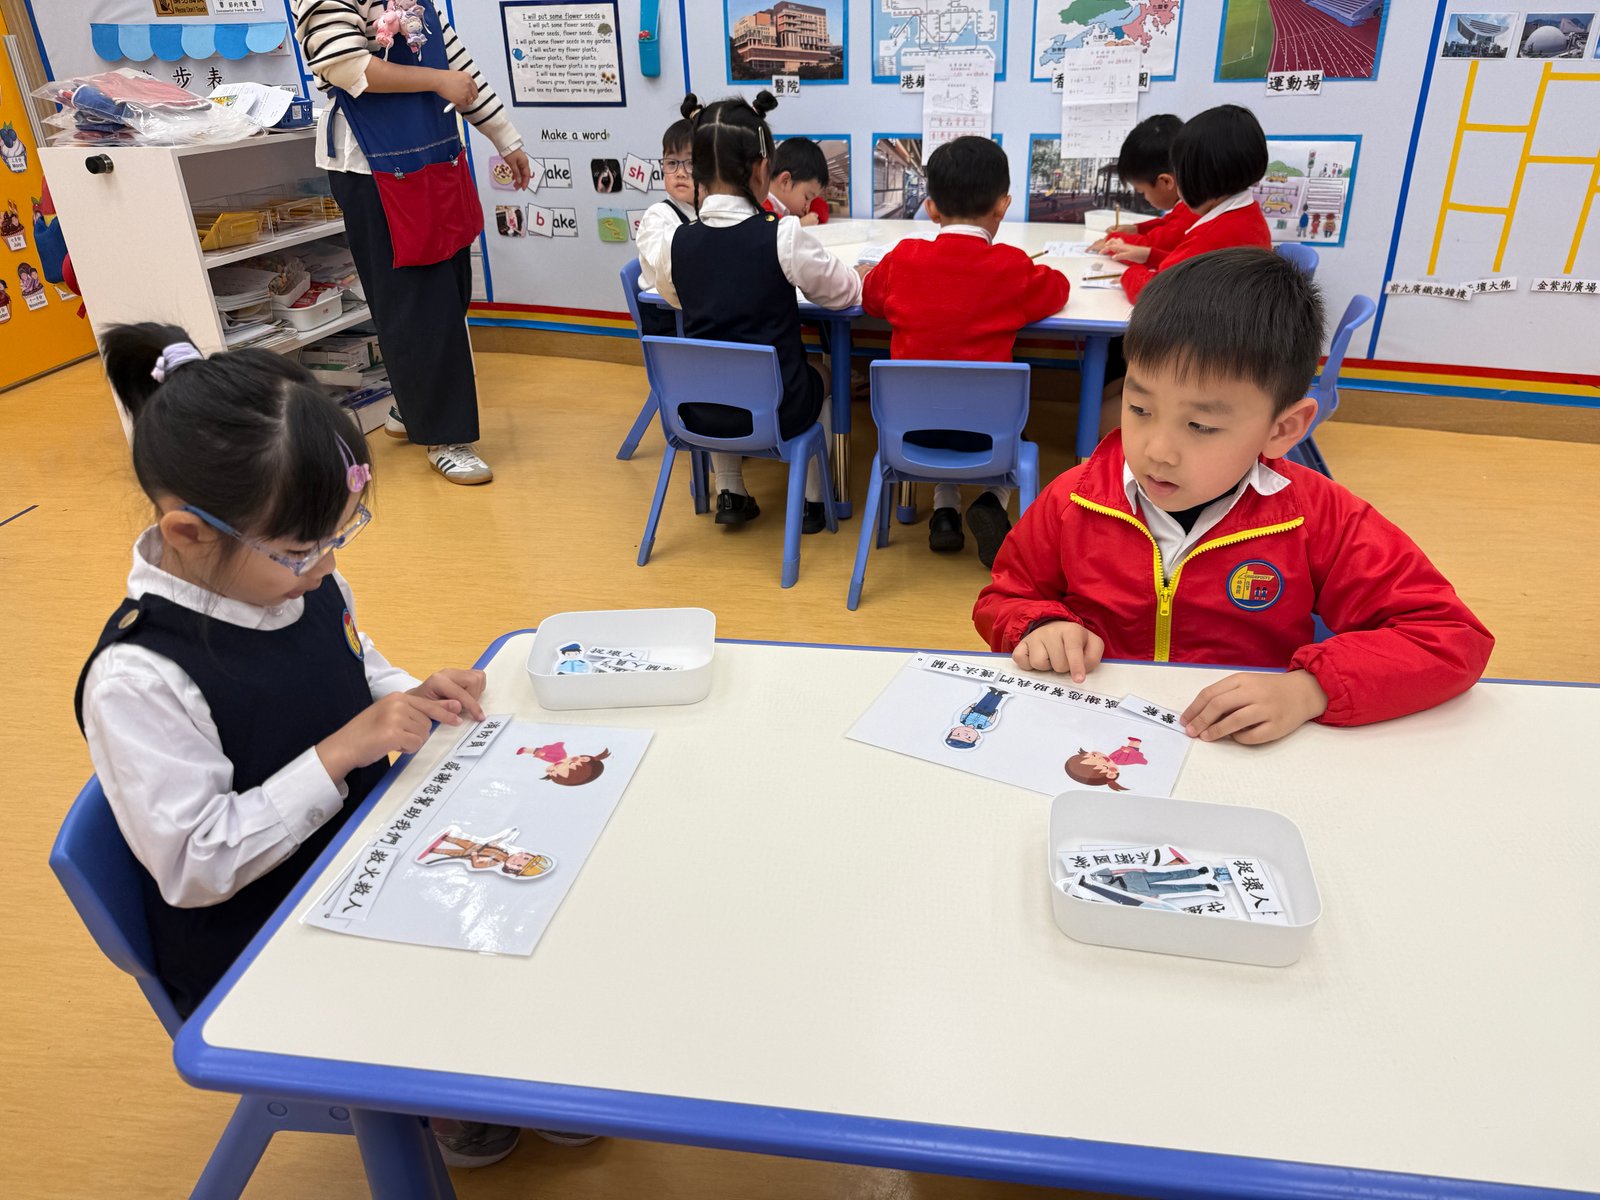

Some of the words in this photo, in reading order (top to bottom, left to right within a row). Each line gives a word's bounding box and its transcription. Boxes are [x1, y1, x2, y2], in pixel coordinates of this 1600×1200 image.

[775, 79, 800, 94] 醫院
[1267, 74, 1321, 92] 運動場
[541, 129, 568, 140] Make
[582, 129, 607, 140] word
[1537, 280, 1597, 294] 金紫荊廣場
[342, 850, 389, 913] 救火救人
[1233, 860, 1270, 909] 捉壞人
